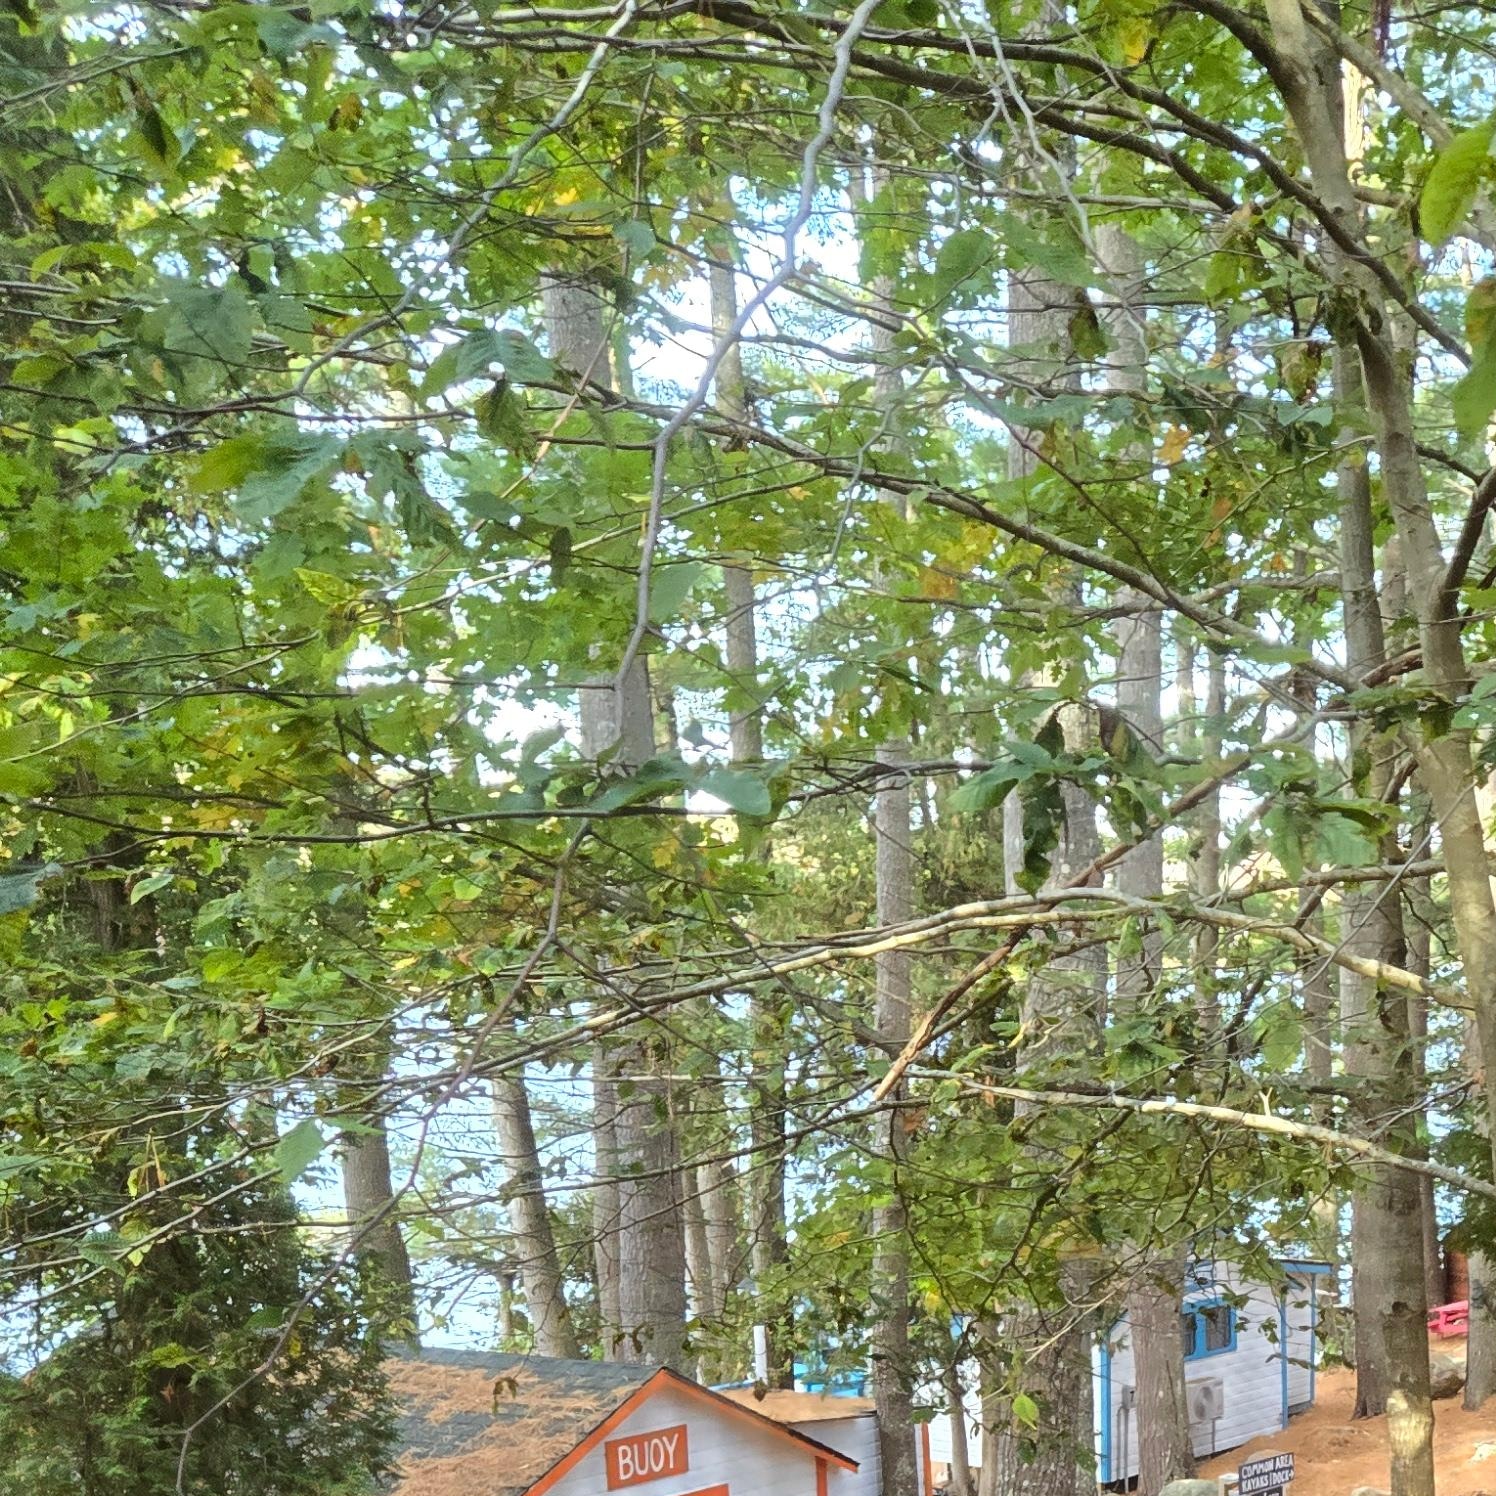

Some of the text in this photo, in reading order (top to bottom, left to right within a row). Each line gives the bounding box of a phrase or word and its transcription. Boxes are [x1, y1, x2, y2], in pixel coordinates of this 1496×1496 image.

[618, 1433, 678, 1480] BUOY
[1242, 1454, 1293, 1480] COMMON AREA
[1242, 1474, 1269, 1492] KAYAKS
